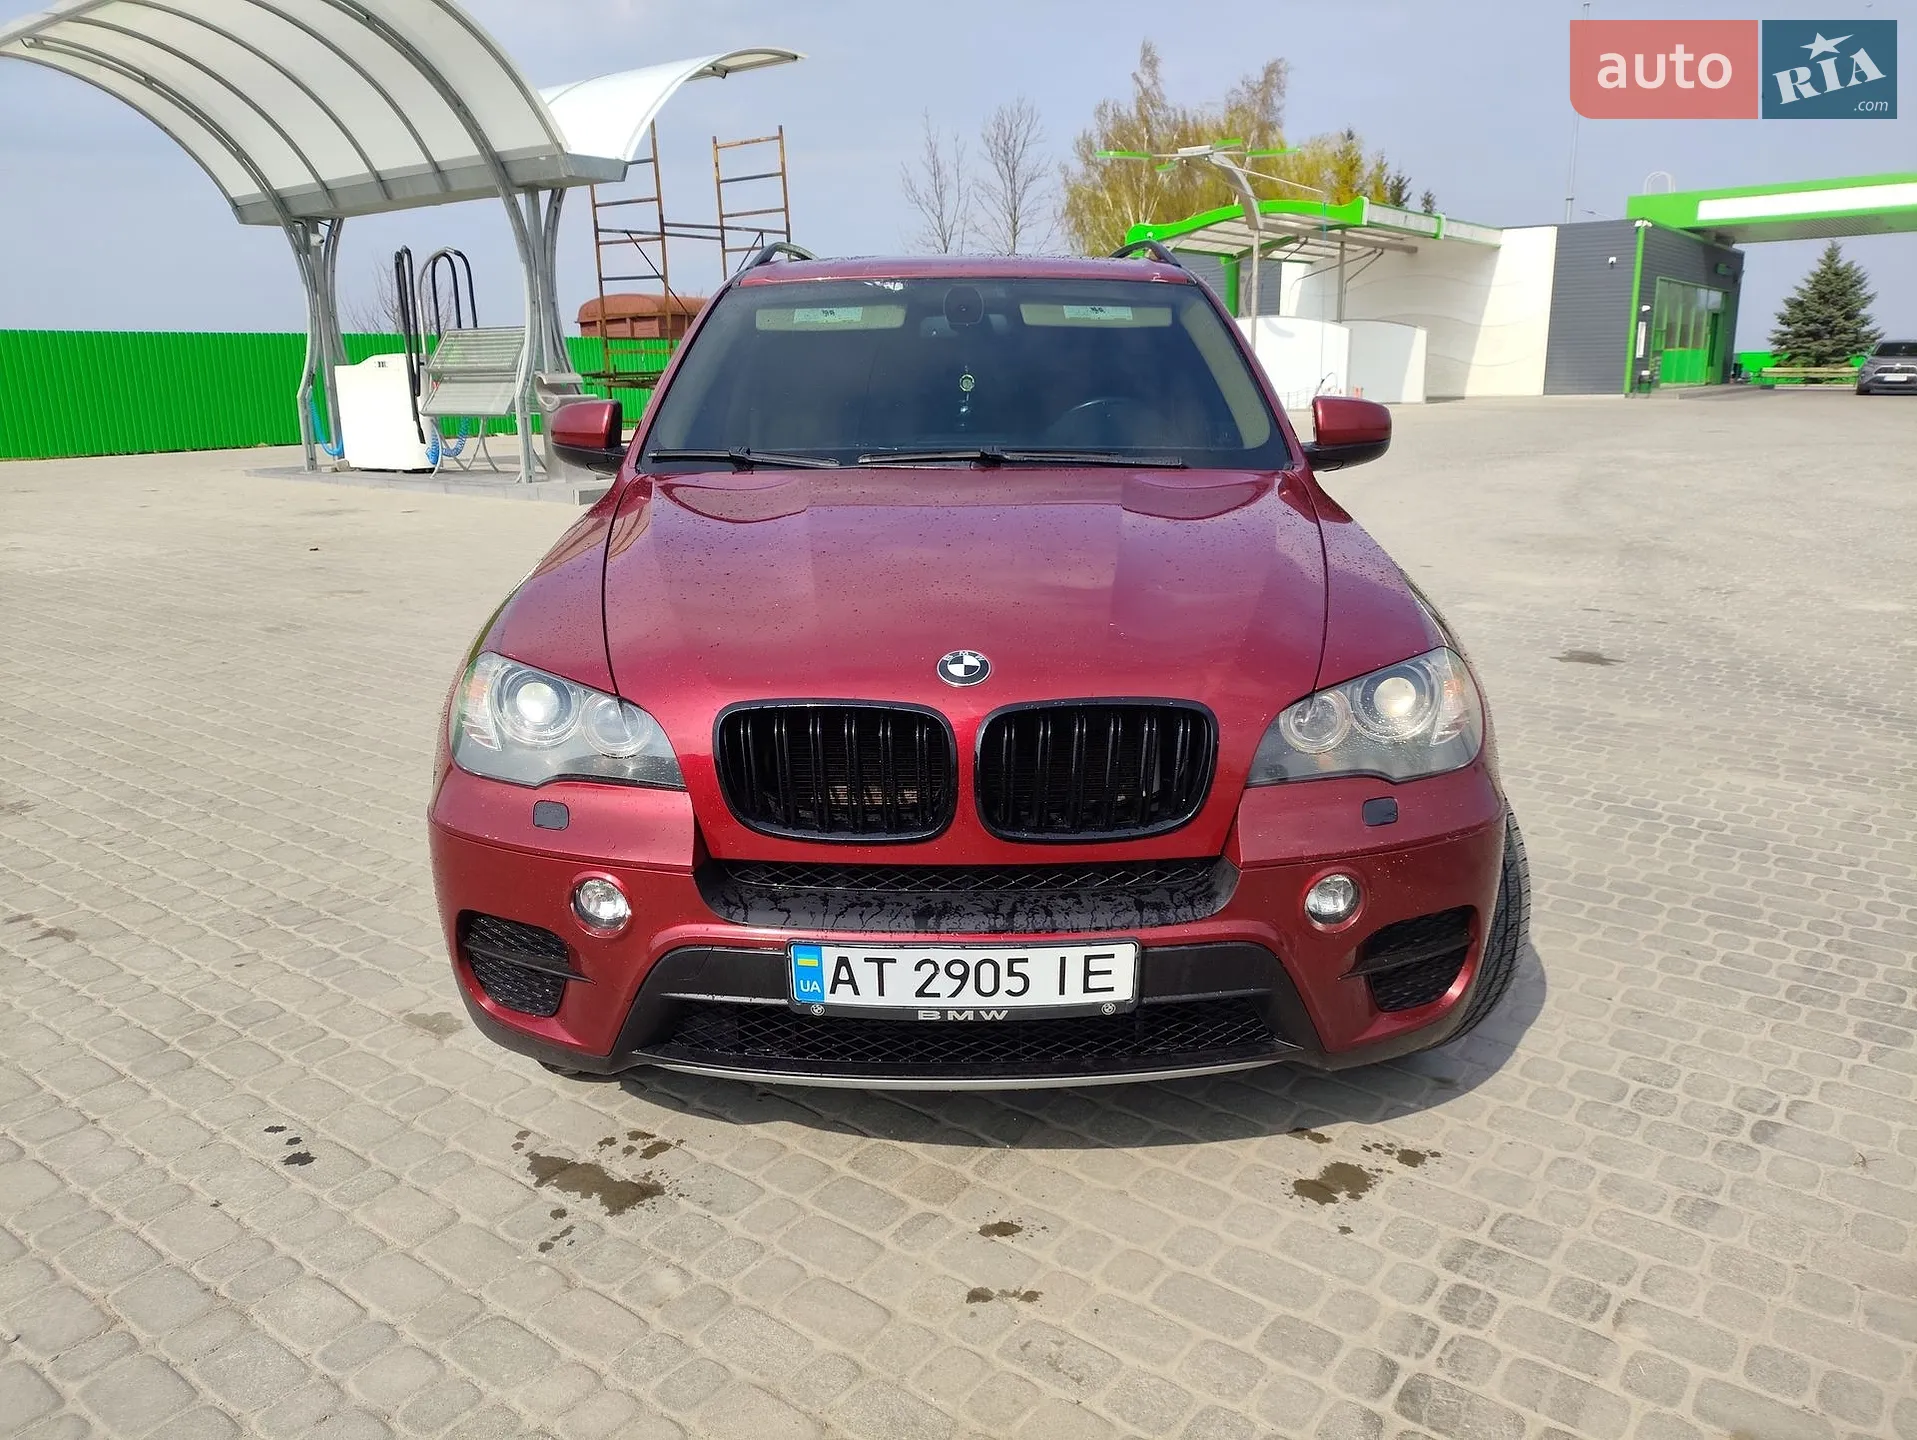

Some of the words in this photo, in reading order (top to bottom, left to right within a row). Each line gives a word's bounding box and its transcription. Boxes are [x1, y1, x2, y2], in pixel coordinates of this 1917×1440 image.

[829, 955, 897, 997] AT
[914, 957, 1030, 998] 2905
[1058, 953, 1115, 996] IE
[800, 980, 822, 993] UA
[917, 1010, 1009, 1021] BMW
